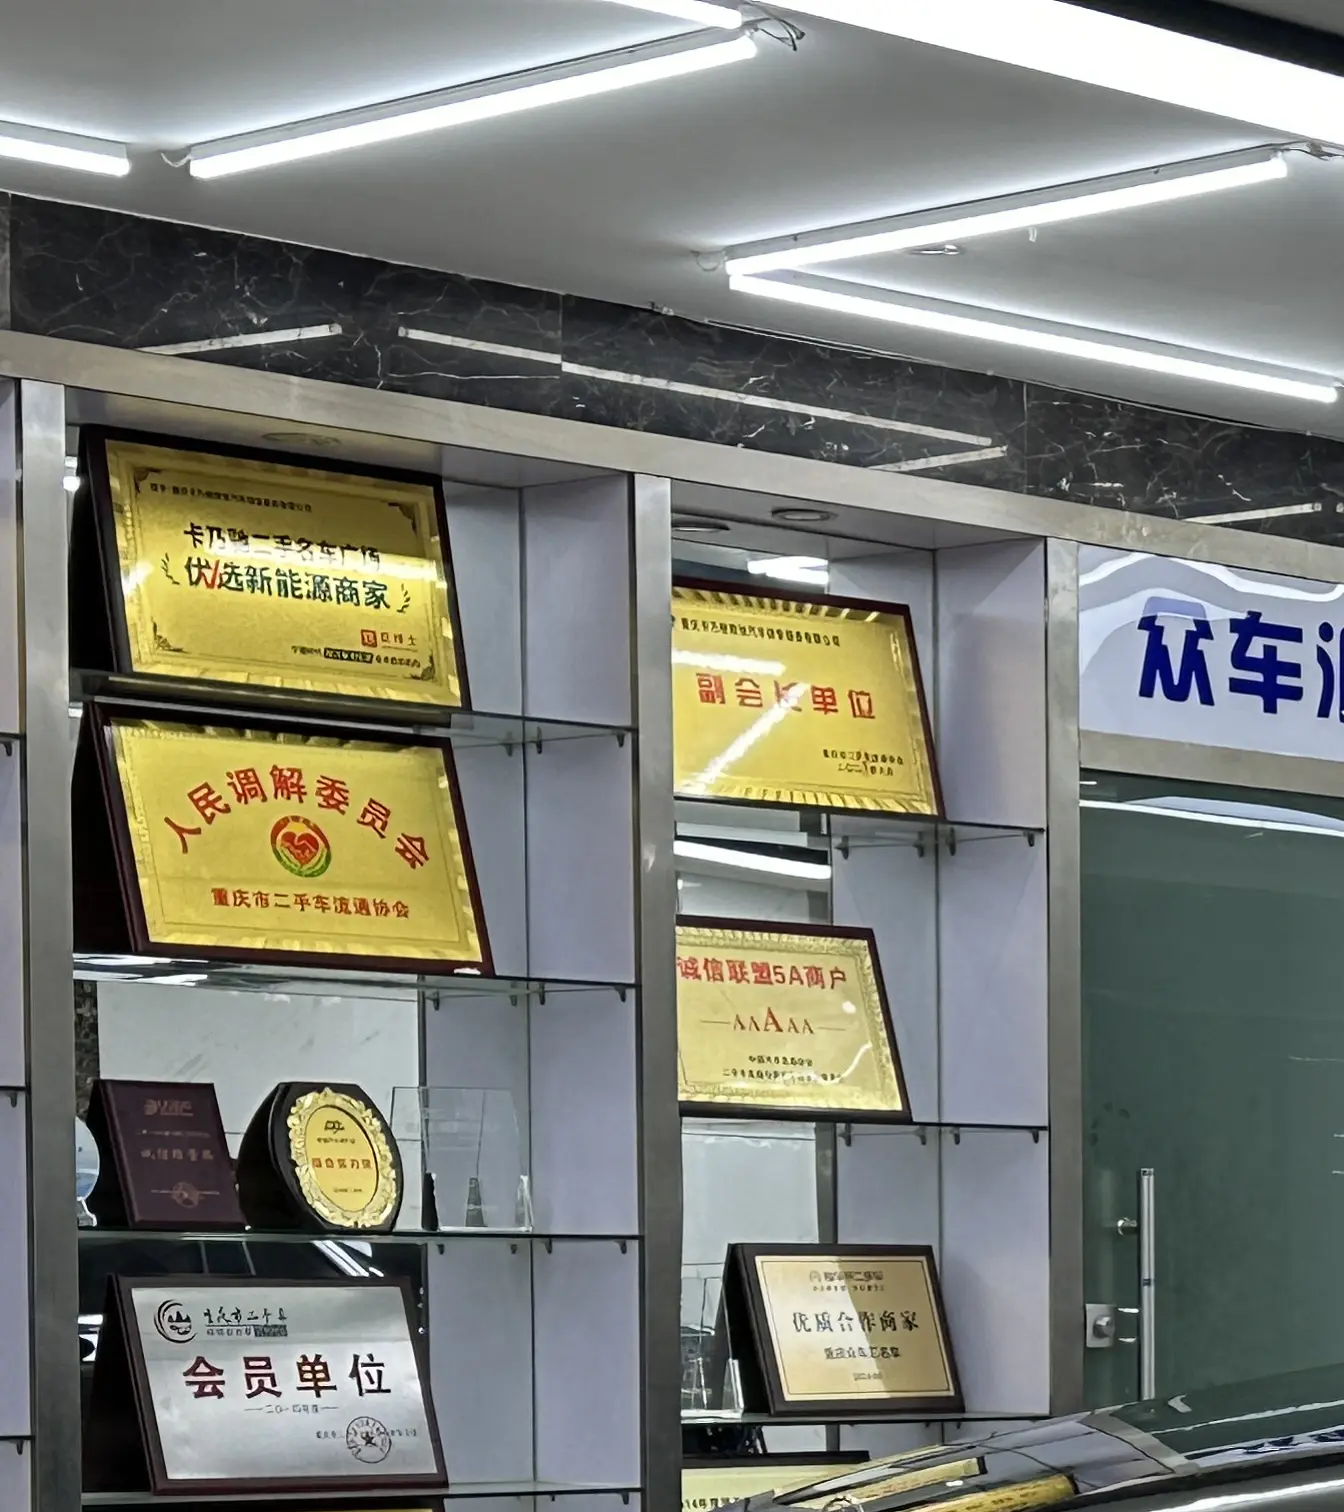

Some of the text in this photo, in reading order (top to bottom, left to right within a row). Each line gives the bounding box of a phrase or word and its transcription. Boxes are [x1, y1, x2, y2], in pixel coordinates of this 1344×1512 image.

[164, 765, 429, 869] 人民调解委员会
[183, 1354, 391, 1399] 会员单位
